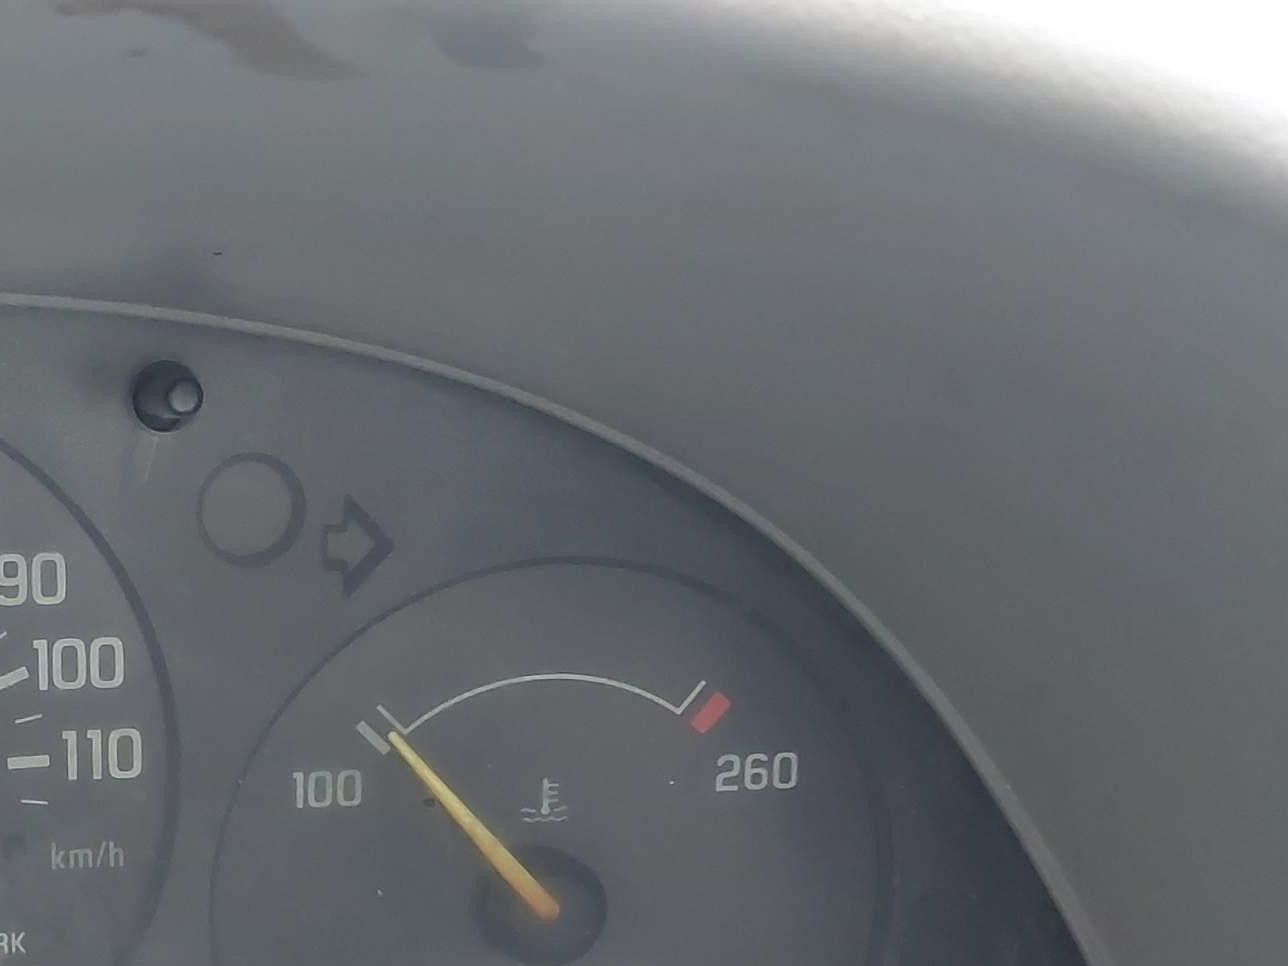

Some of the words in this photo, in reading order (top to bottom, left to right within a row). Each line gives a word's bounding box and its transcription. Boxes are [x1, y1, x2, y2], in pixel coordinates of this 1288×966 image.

[32, 637, 125, 691] 100
[61, 728, 143, 780] 110
[715, 751, 799, 792] 260
[293, 769, 363, 808] 100
[50, 841, 125, 870] km/h
